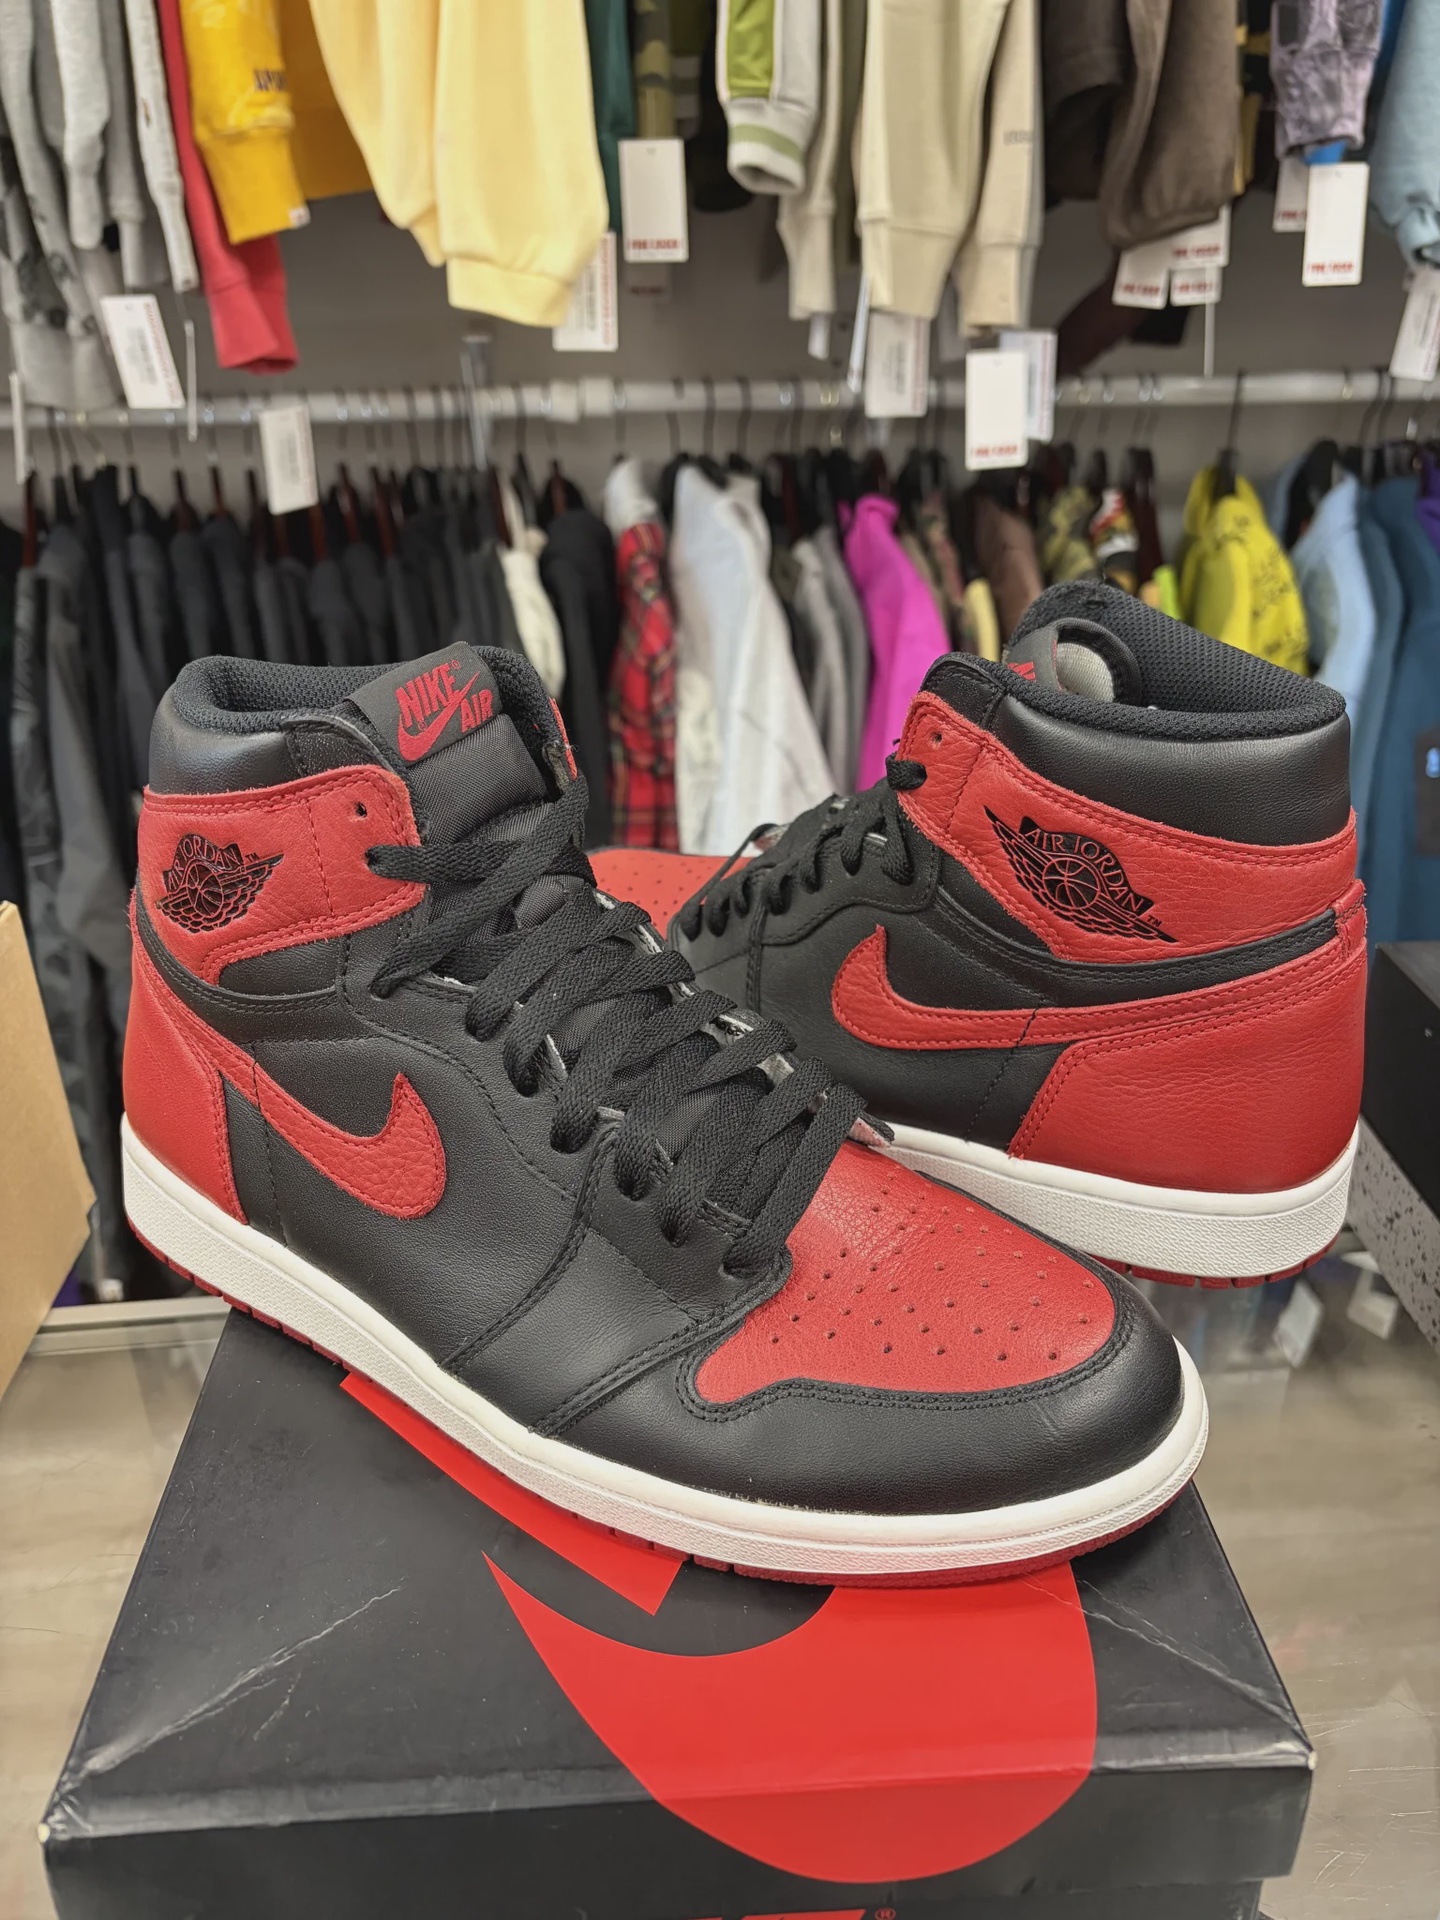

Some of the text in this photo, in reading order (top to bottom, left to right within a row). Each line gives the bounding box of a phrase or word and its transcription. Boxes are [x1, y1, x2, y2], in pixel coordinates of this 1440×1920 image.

[395, 663, 459, 726] NIKE
[461, 689, 493, 734] AIR
[167, 858, 185, 891] AIR
[179, 836, 242, 869] JORDAN
[1024, 827, 1065, 853] AIR
[1073, 835, 1144, 913] JORDAN
